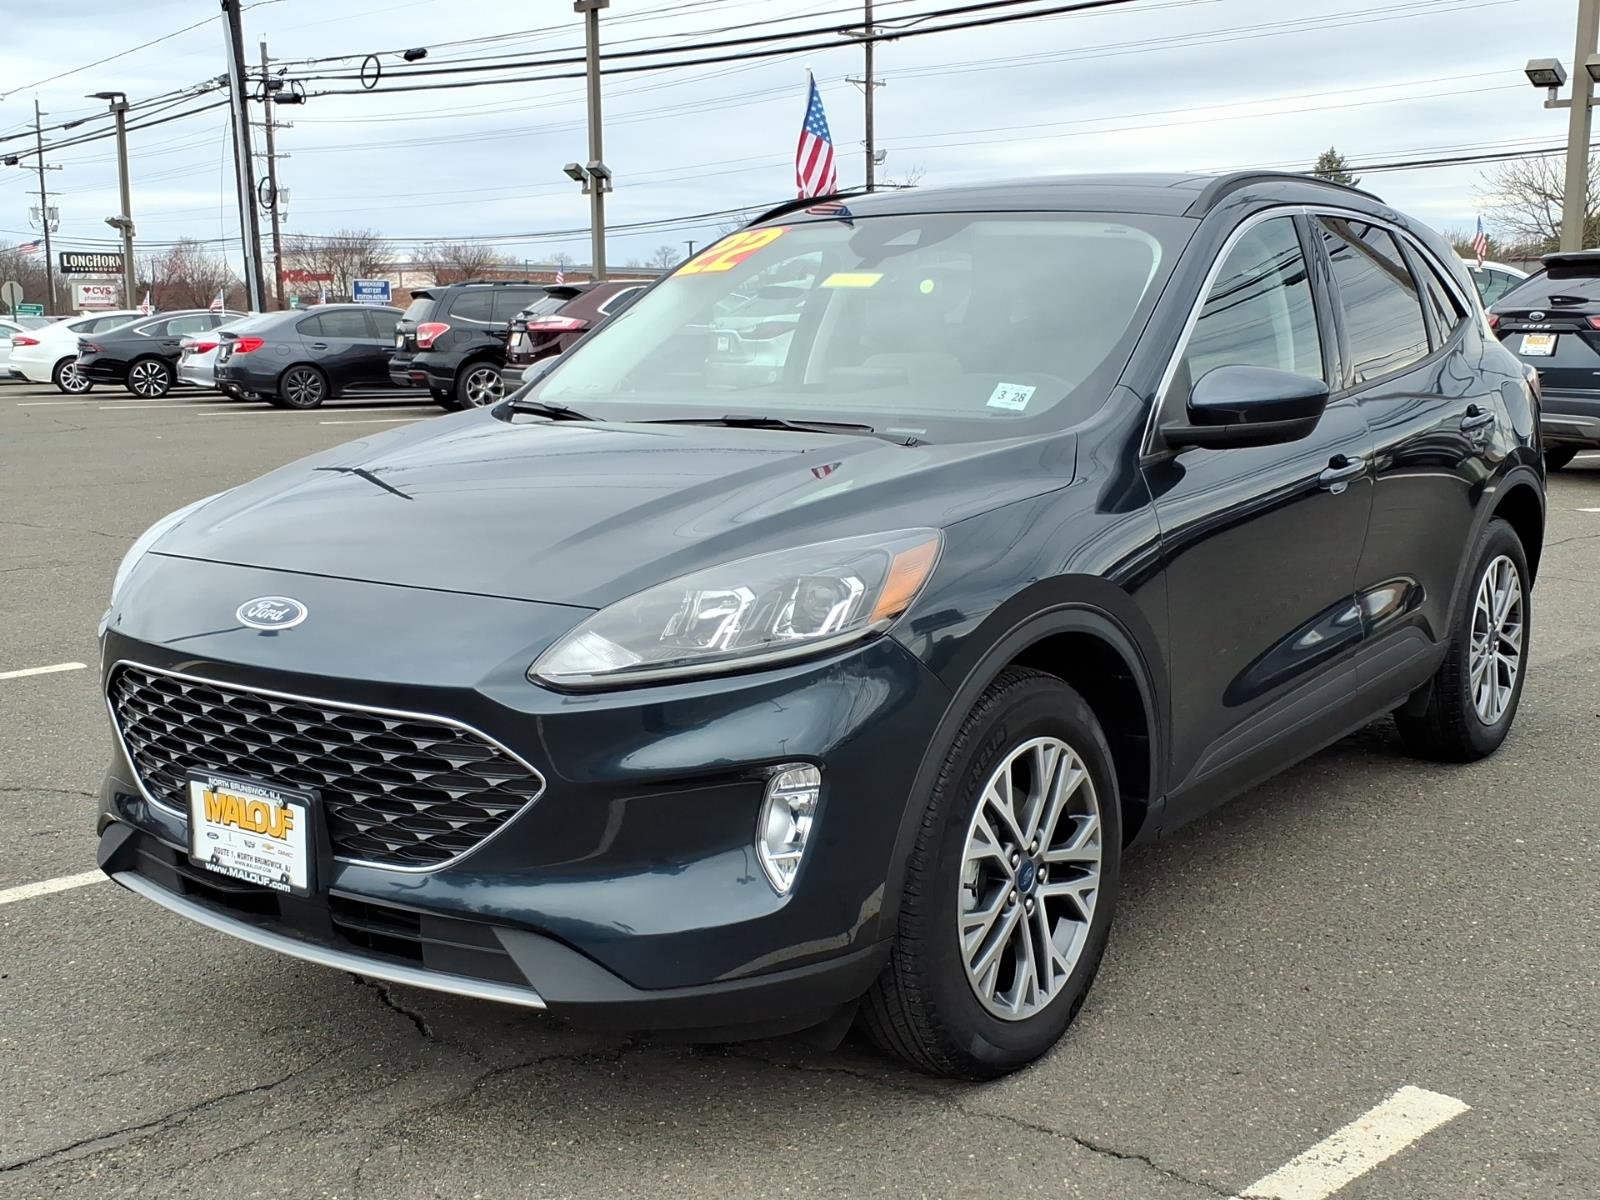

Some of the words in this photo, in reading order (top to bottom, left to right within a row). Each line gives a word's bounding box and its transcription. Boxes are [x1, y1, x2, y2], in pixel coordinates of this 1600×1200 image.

[674, 227, 784, 274] 22
[63, 254, 122, 267] LONGHORN
[92, 286, 111, 295] CVS
[1010, 392, 1027, 402] 28
[247, 600, 290, 621] Ford
[208, 777, 229, 788] NORTH
[203, 789, 293, 841] MALOUF
[213, 846, 229, 857] ROUTE
[237, 852, 254, 863] NORTH
[205, 862, 291, 893] www.MALOUF.com
